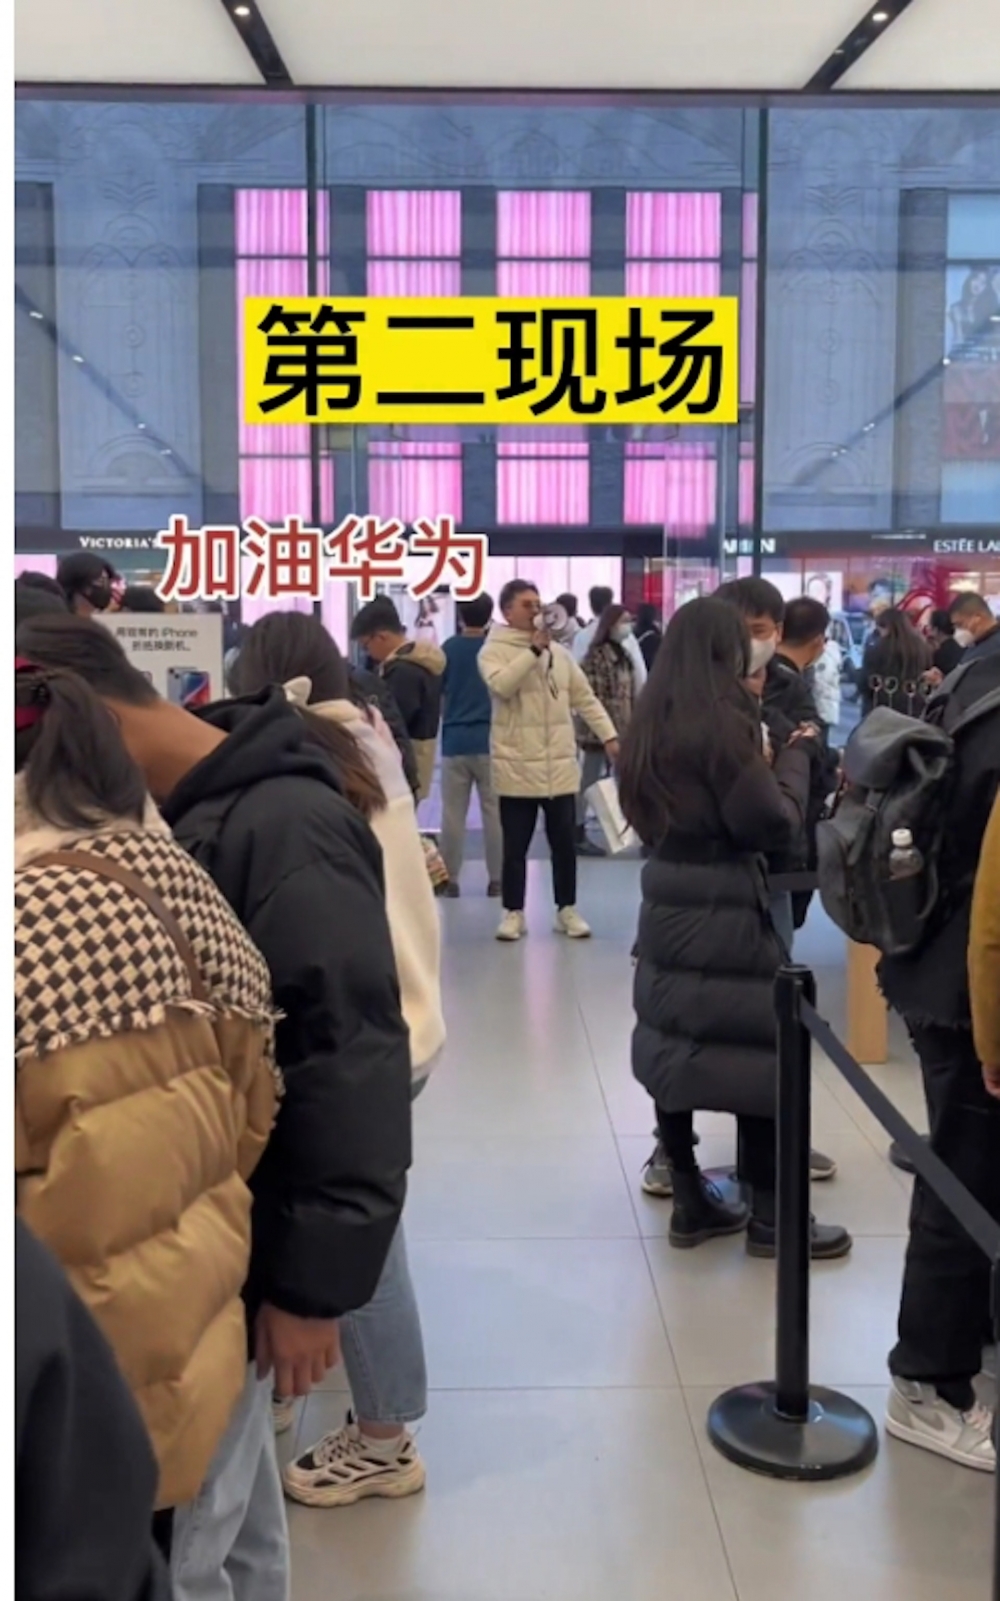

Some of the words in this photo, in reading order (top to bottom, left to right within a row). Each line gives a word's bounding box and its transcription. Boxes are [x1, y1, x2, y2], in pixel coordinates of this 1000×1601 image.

[79, 536, 159, 549] VICTORIA'S
[933, 537, 975, 553] ESTÉE
[161, 626, 198, 638] iPhone
